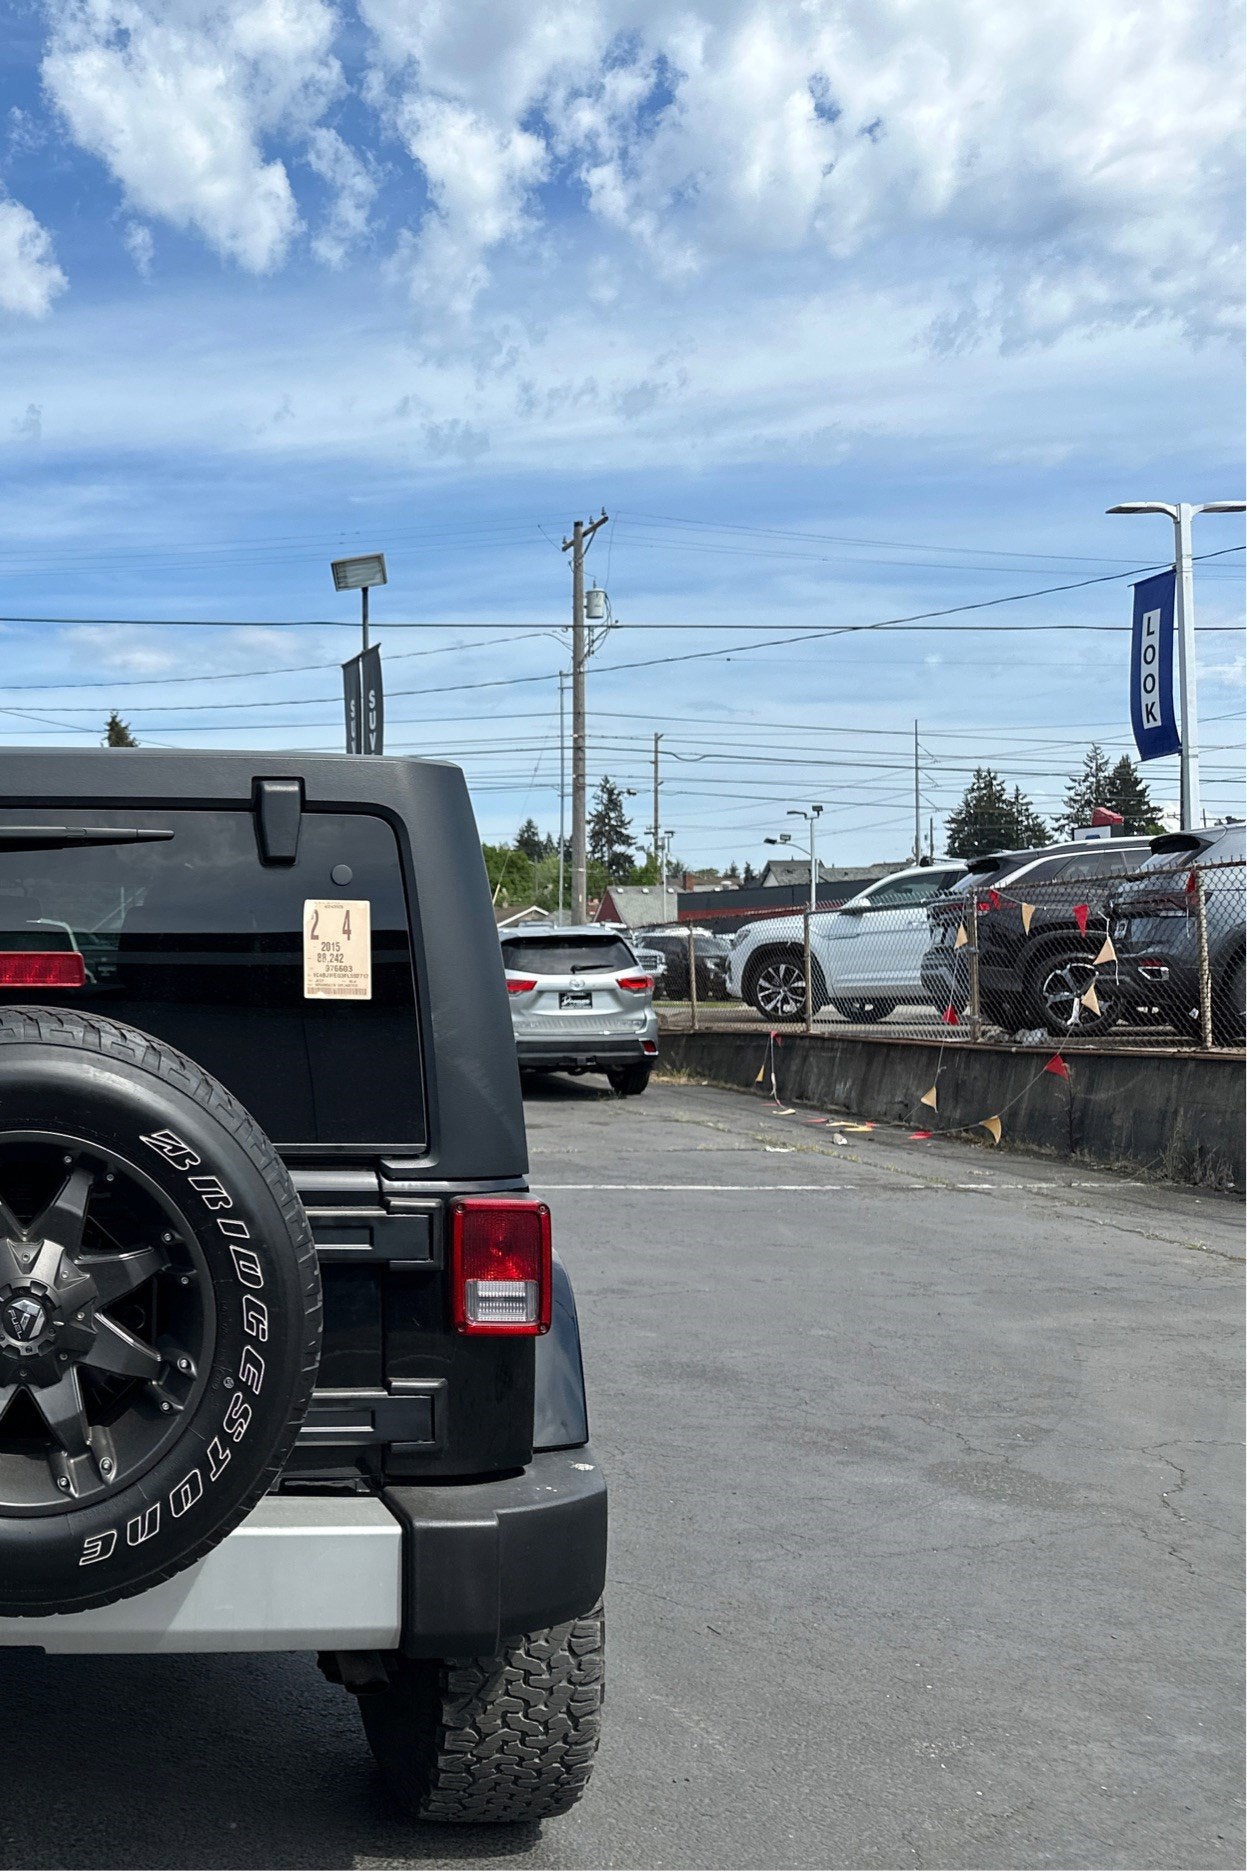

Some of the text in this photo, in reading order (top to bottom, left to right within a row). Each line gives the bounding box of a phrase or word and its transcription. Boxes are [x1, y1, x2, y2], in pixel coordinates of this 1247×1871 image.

[1143, 616, 1157, 723] LOOK
[368, 690, 377, 755] SUV
[320, 941, 341, 952] 2015
[342, 909, 352, 941] 4
[8, 1309, 22, 1339] FUEL
[78, 1130, 270, 1566] BRIDGESTONE
